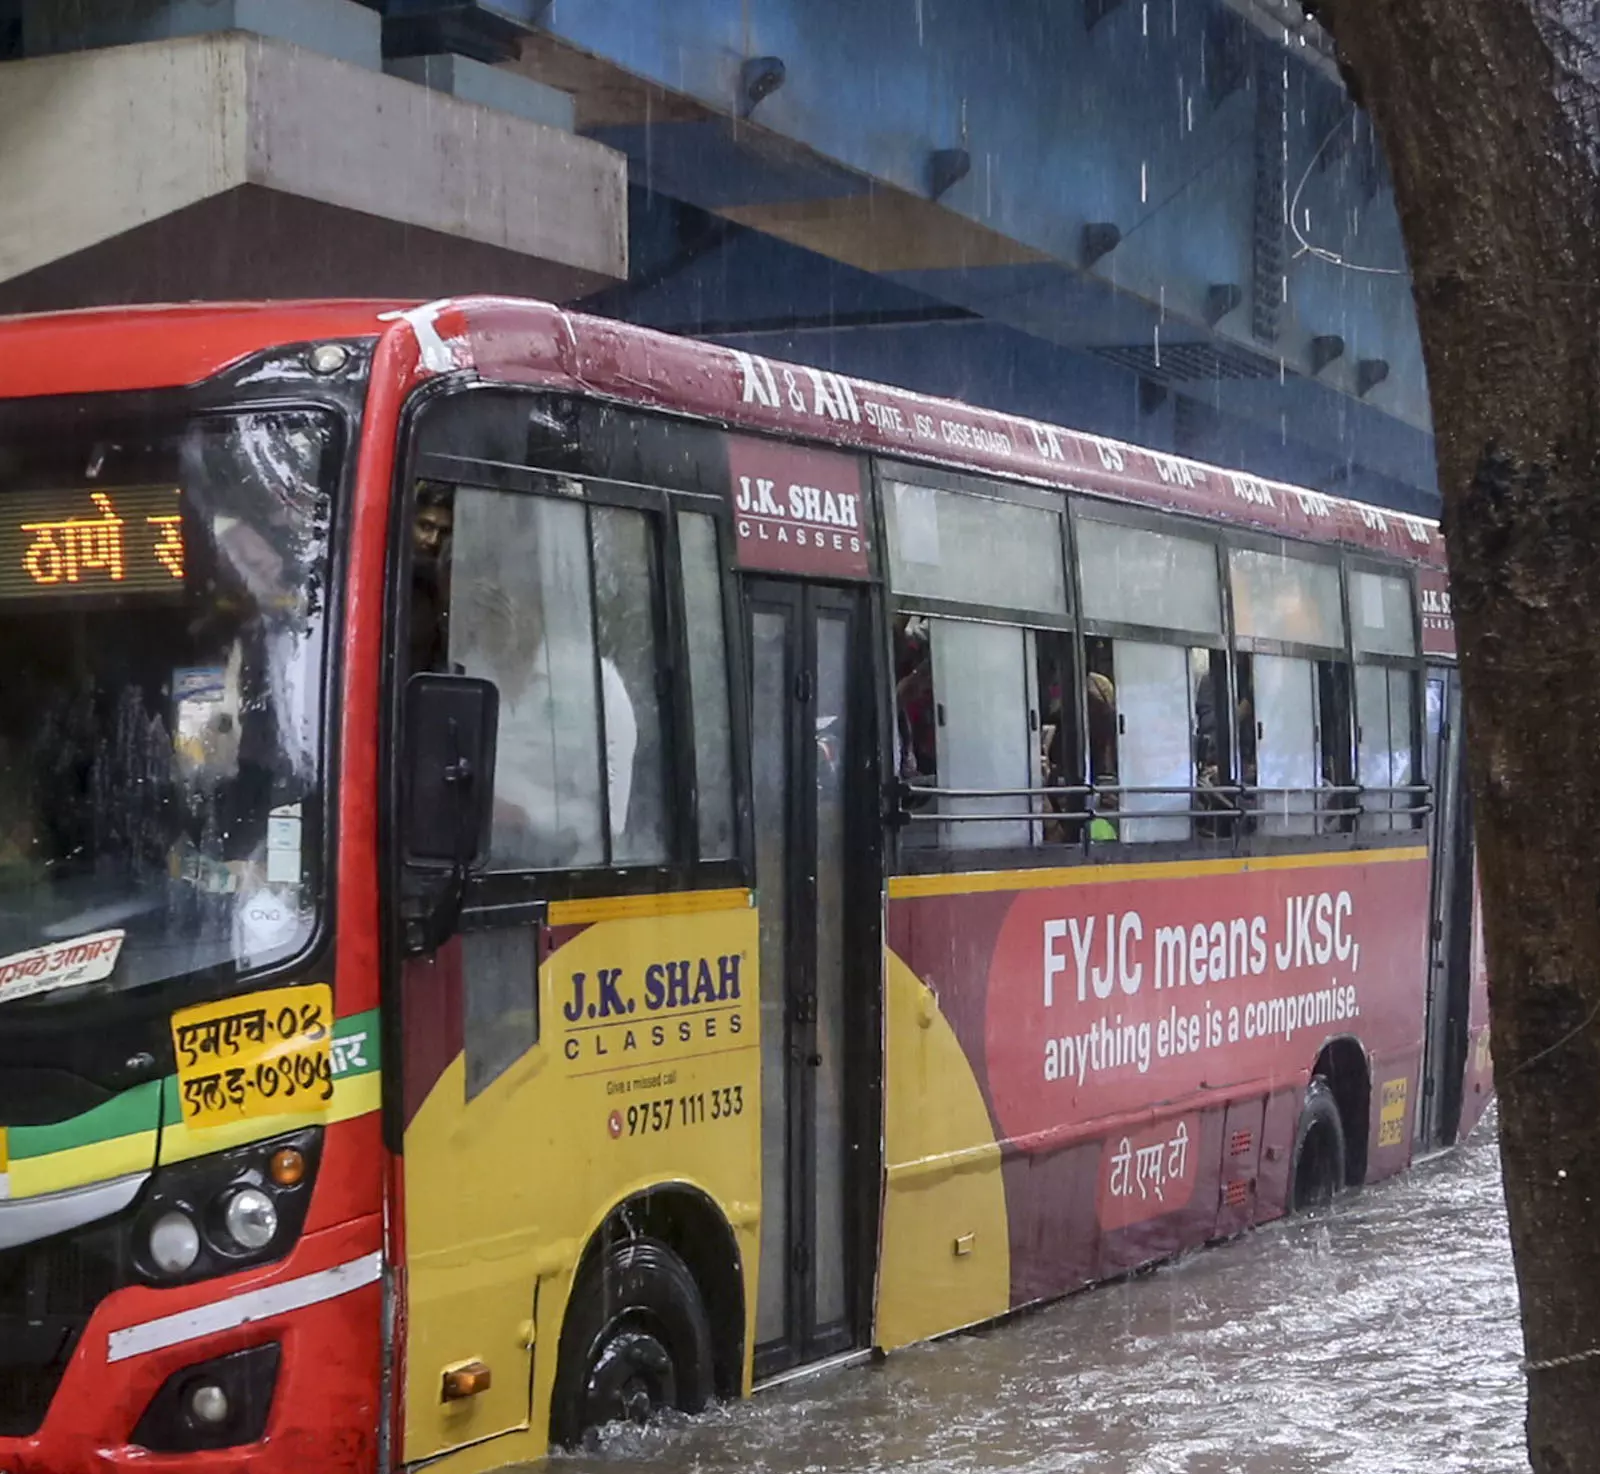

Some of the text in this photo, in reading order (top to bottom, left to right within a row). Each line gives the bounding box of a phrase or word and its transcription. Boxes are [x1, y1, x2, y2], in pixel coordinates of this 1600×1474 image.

[782, 369, 807, 412] &
[1031, 424, 1065, 461] CA
[736, 476, 858, 527] J.K. SHAH
[21, 493, 124, 583] ठाणे
[739, 521, 860, 552] CLASSES
[1044, 890, 1360, 1007] FYJC means JKSC,
[564, 954, 741, 1021] J.K. SHAH
[564, 1014, 742, 1060] CLASSES
[1044, 978, 1360, 1087] anything else is a compromise.
[606, 1079, 626, 1095] Give
[633, 1074, 662, 1089] missed
[663, 1070, 677, 1085] call
[627, 1085, 743, 1136] 9757 111 333
